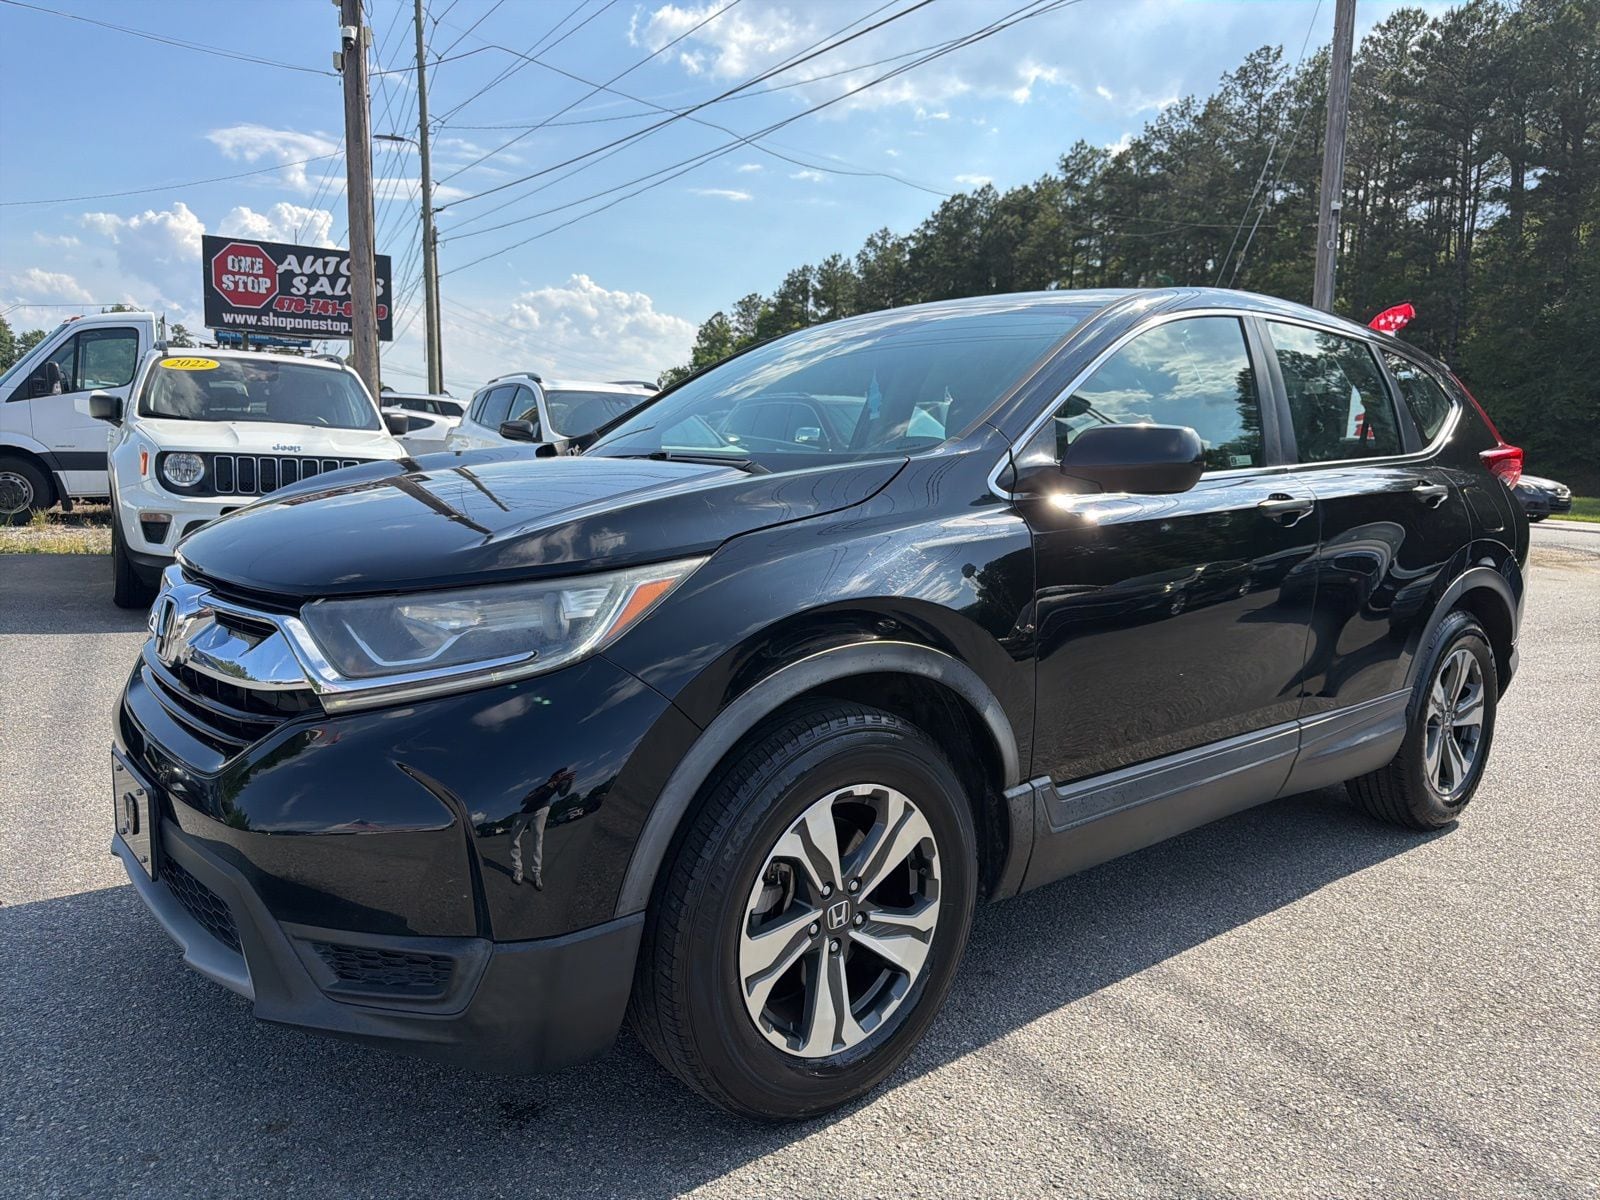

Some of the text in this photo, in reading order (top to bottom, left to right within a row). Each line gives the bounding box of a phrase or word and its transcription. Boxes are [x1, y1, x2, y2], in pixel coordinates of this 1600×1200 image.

[227, 255, 264, 274] ONE
[222, 274, 271, 294] STOP
[170, 360, 209, 368] 2022
